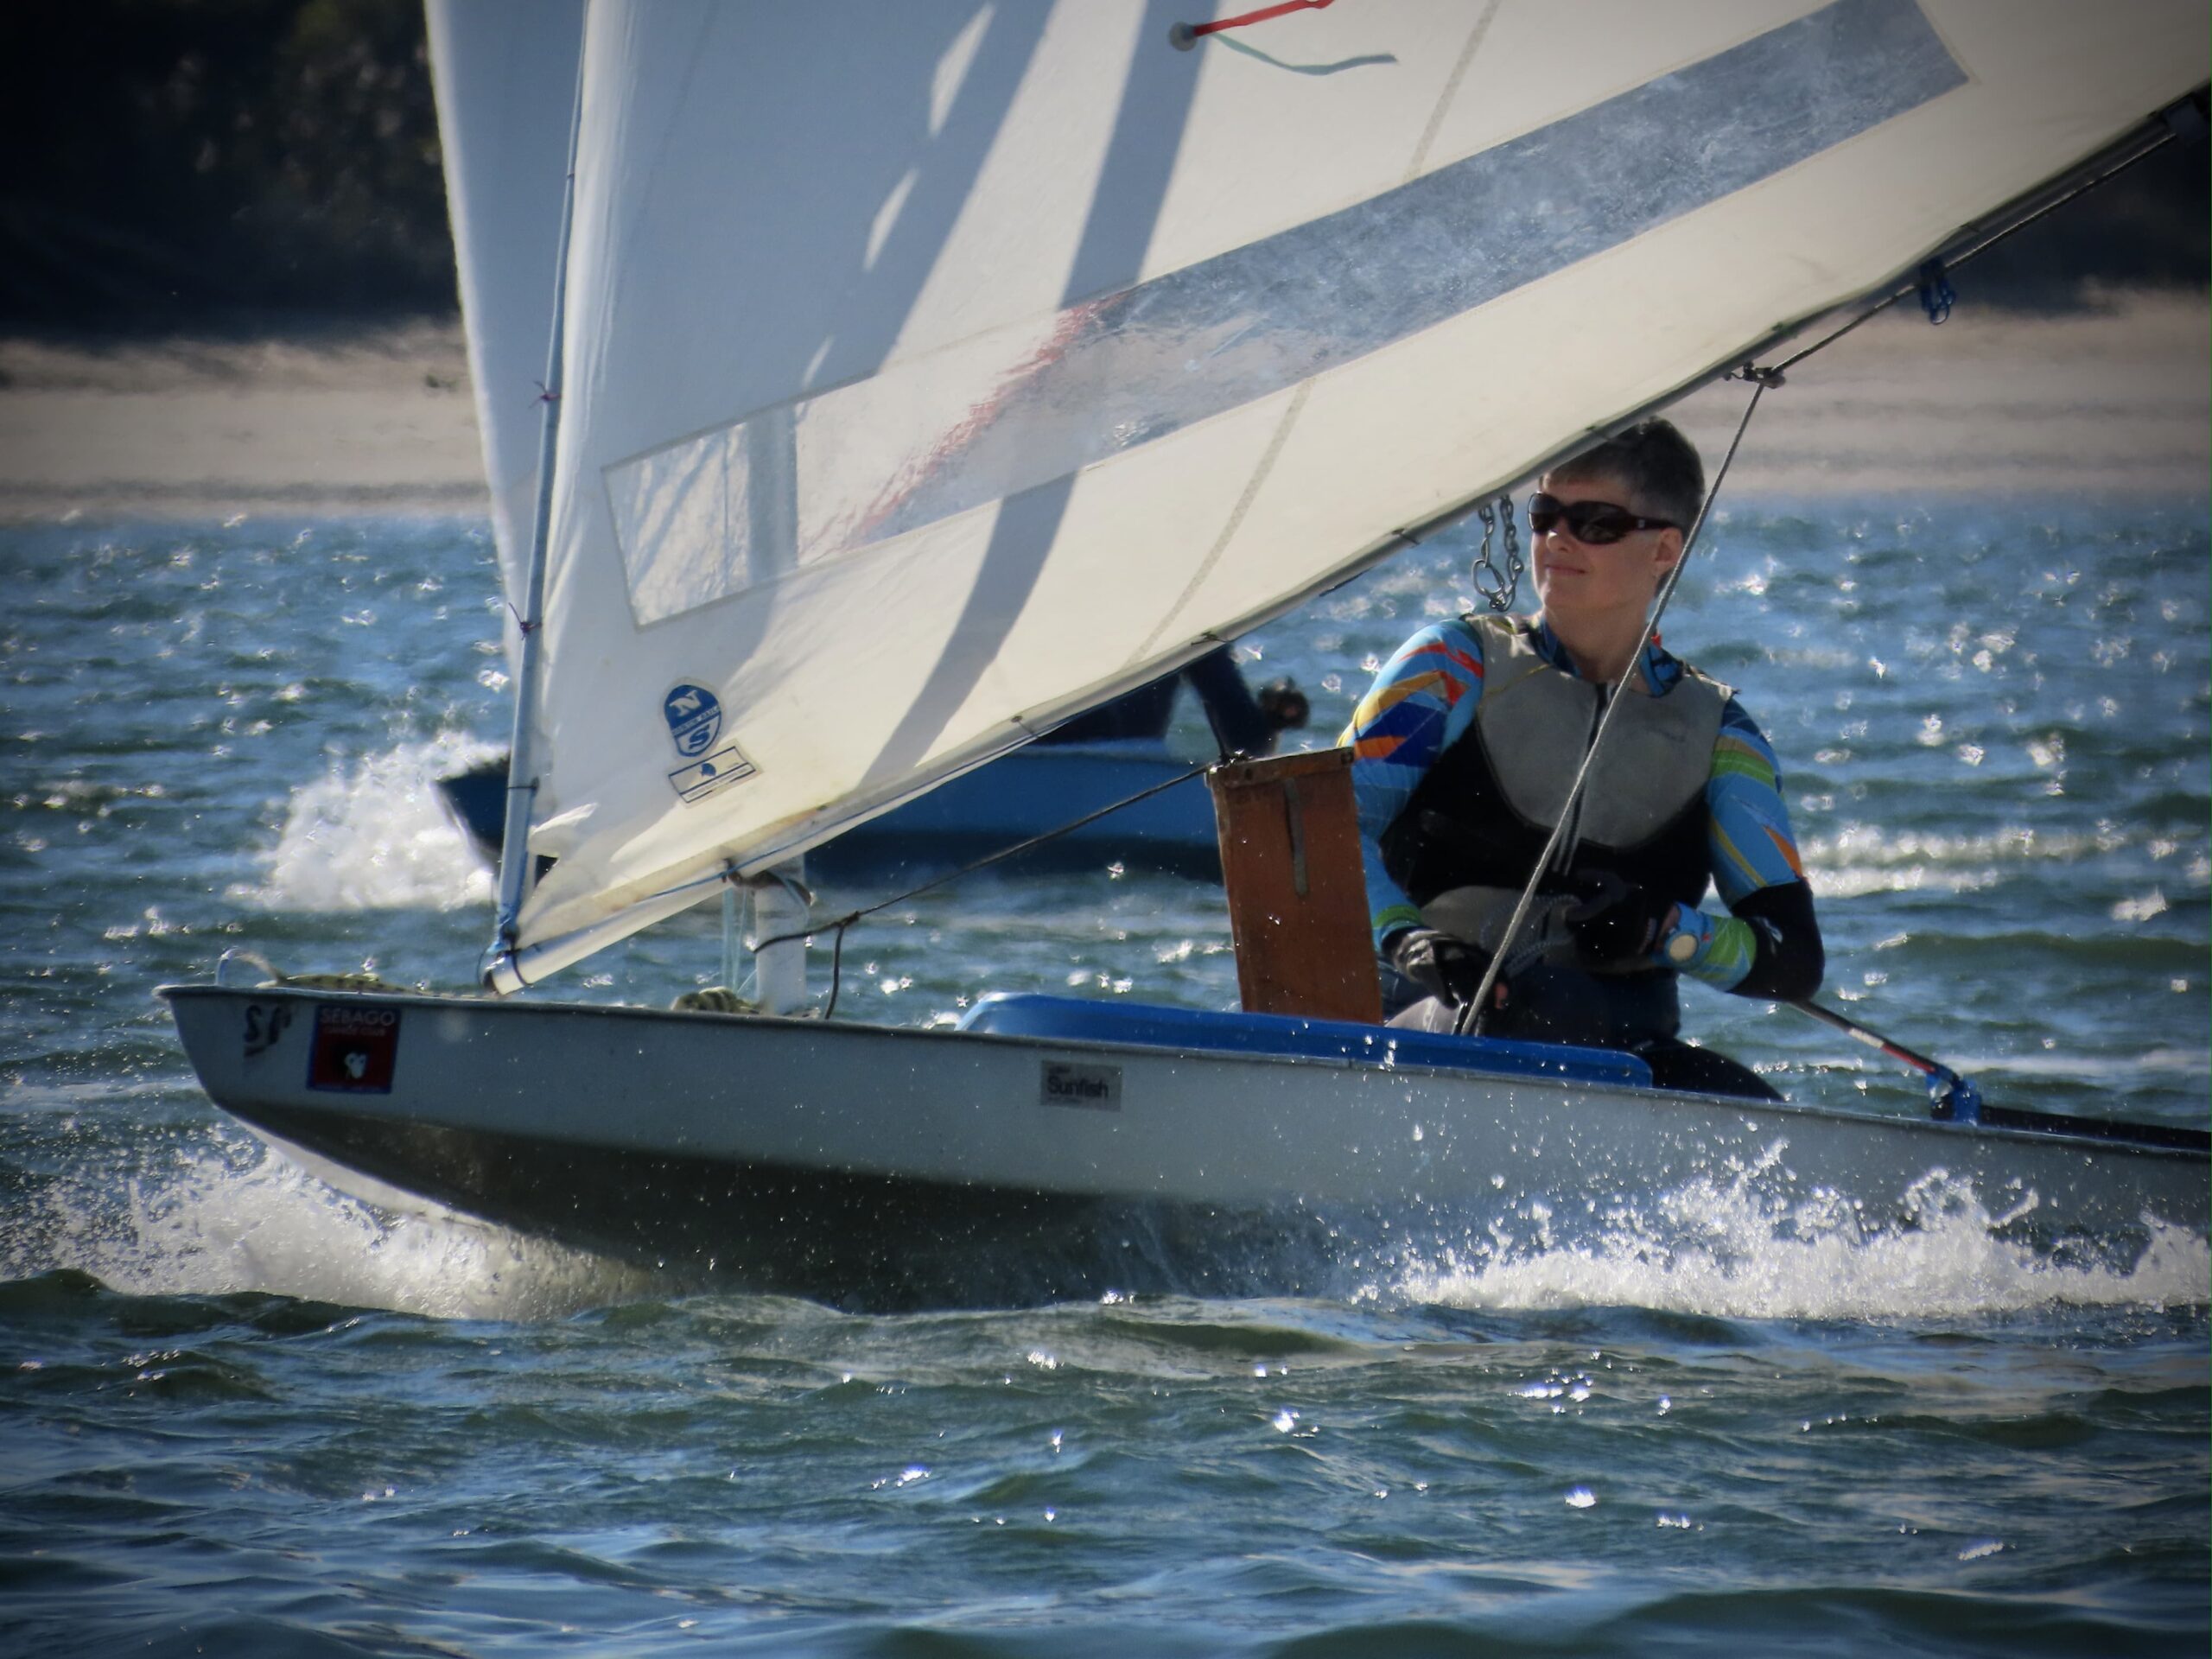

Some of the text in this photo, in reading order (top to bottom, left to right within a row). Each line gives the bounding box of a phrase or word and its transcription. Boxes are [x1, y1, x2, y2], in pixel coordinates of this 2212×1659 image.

[689, 724, 710, 750] S
[320, 1007, 396, 1027] SEBAGO
[1047, 1075, 1109, 1098] Sunfish
